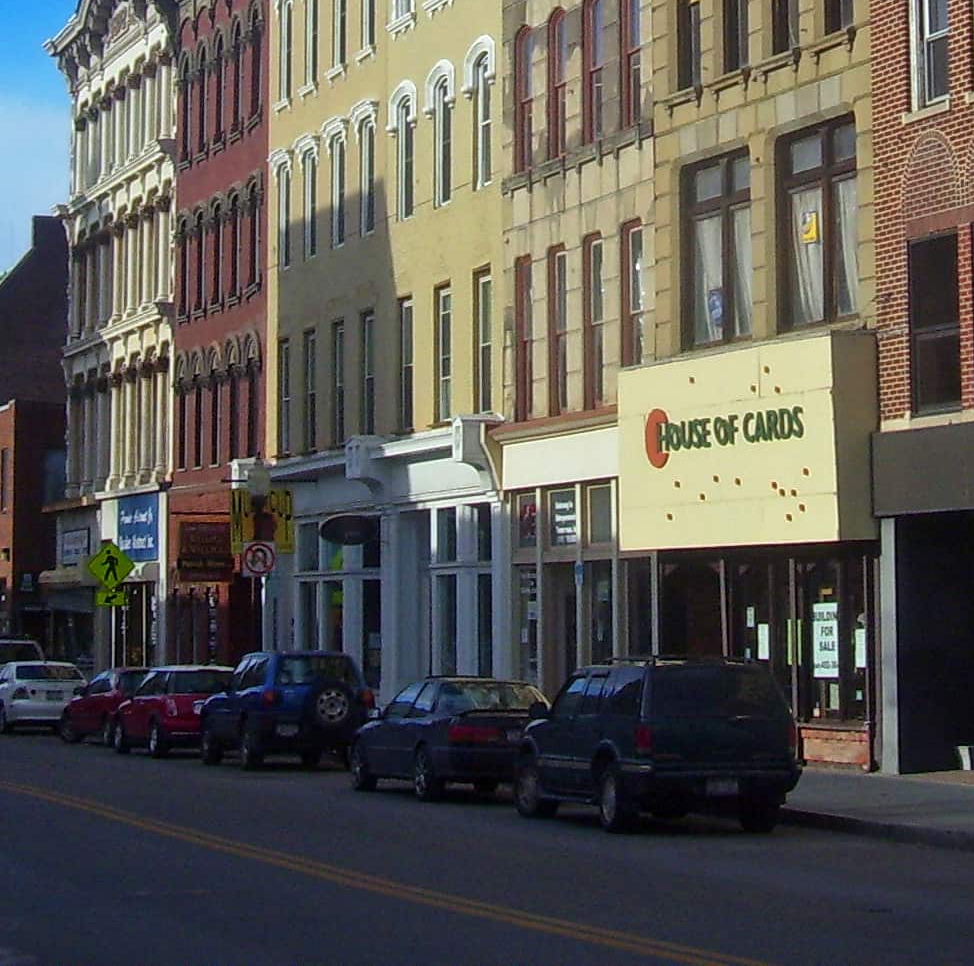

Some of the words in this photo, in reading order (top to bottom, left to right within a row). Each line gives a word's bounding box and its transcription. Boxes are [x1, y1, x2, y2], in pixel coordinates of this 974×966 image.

[656, 417, 712, 452] HOUSE
[713, 414, 739, 447] OF
[742, 405, 805, 444] CARDS
[820, 625, 834, 637] FOR
[819, 640, 835, 652] SALE
